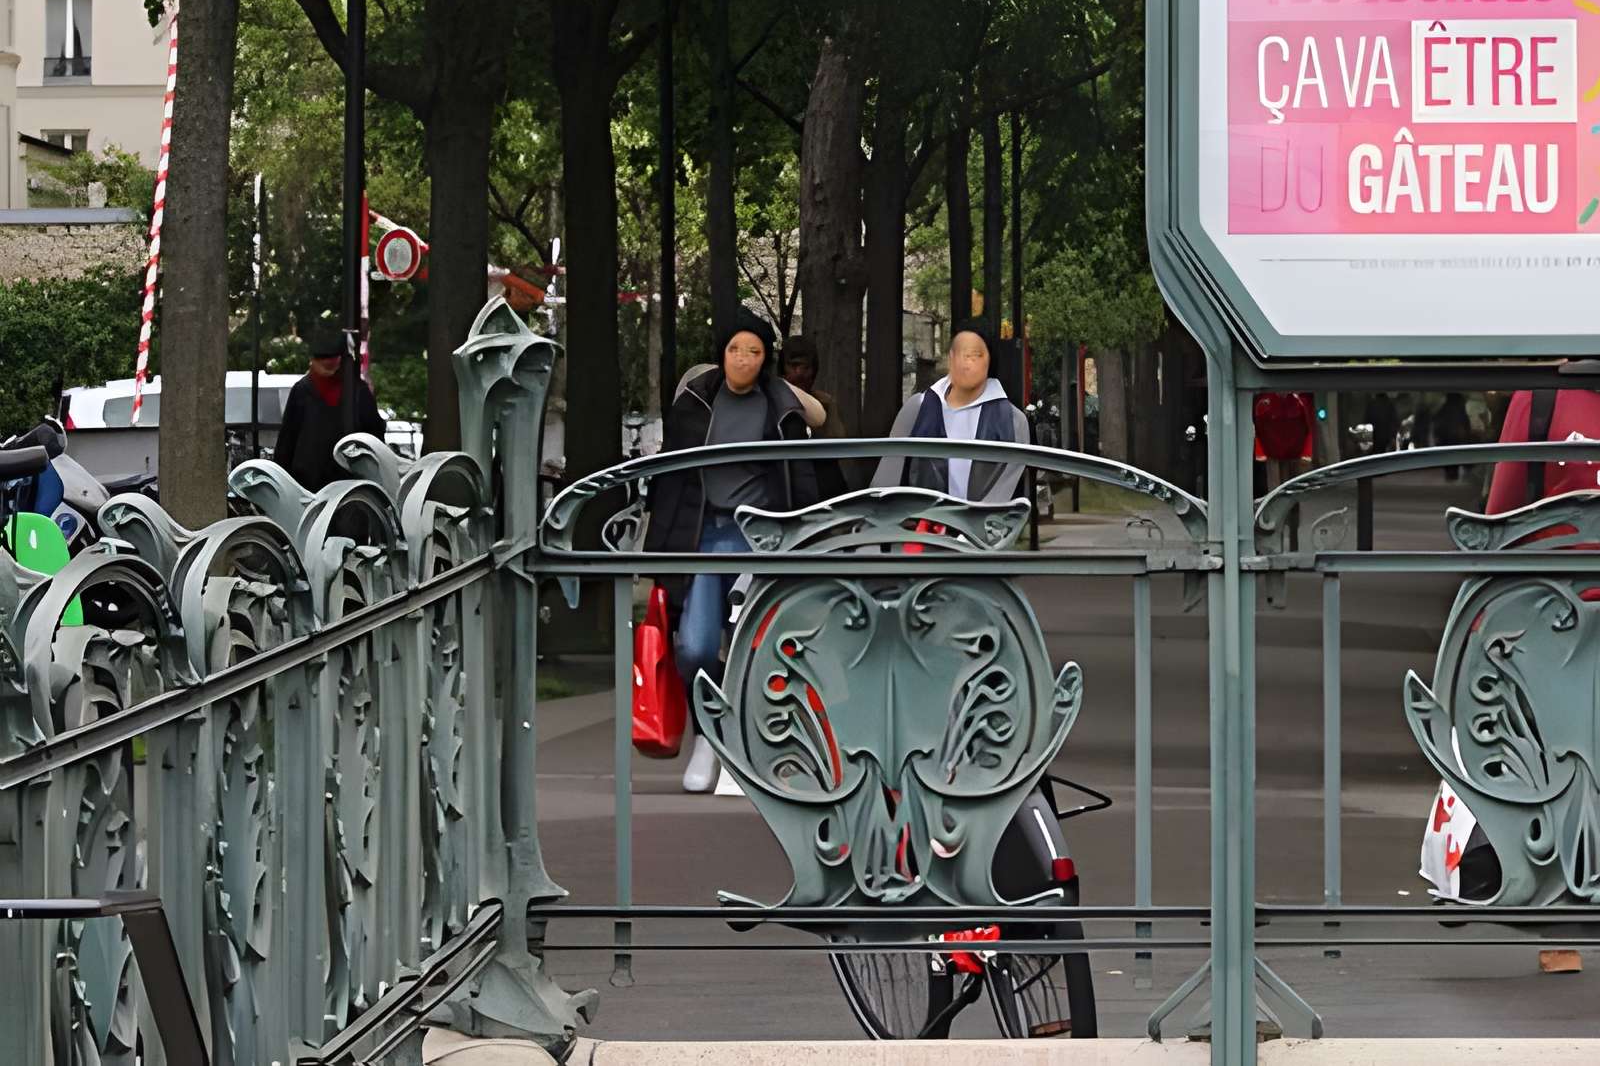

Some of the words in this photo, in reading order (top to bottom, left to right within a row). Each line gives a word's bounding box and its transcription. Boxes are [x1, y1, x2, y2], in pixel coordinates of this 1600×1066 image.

[1257, 35, 1329, 124] ÇA
[1335, 35, 1401, 108] VA
[1423, 20, 1558, 106] ÊTRE
[1260, 139, 1324, 213] DU
[1348, 125, 1559, 214] GÂTEAU
